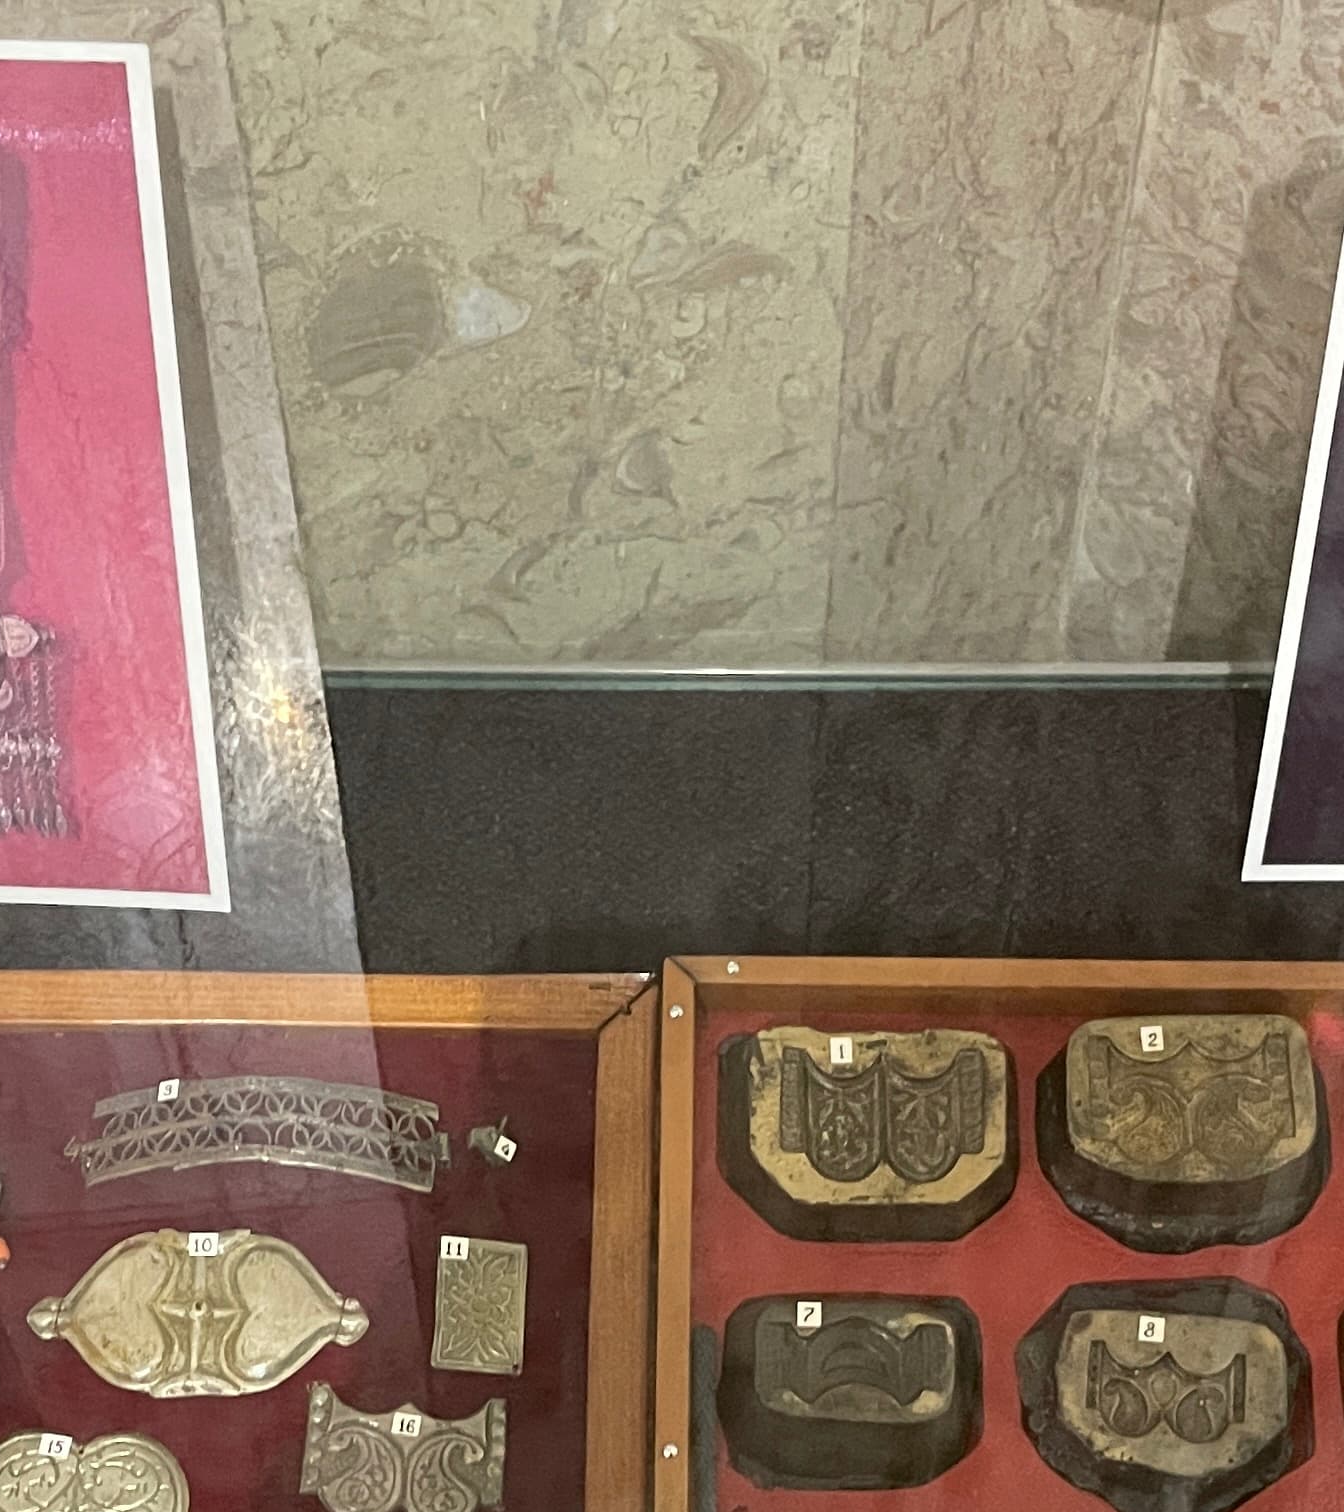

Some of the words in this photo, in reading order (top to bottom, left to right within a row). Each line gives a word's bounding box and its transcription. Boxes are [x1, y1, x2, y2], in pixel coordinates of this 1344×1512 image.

[1147, 1032, 1158, 1048] 2
[839, 1044, 845, 1060] 1
[194, 1236, 212, 1253] 10
[446, 1241, 462, 1257] 11
[803, 1306, 815, 1323] 7
[1143, 1321, 1156, 1338] 8
[399, 1418, 416, 1434] 16
[47, 1439, 64, 1454] 15
